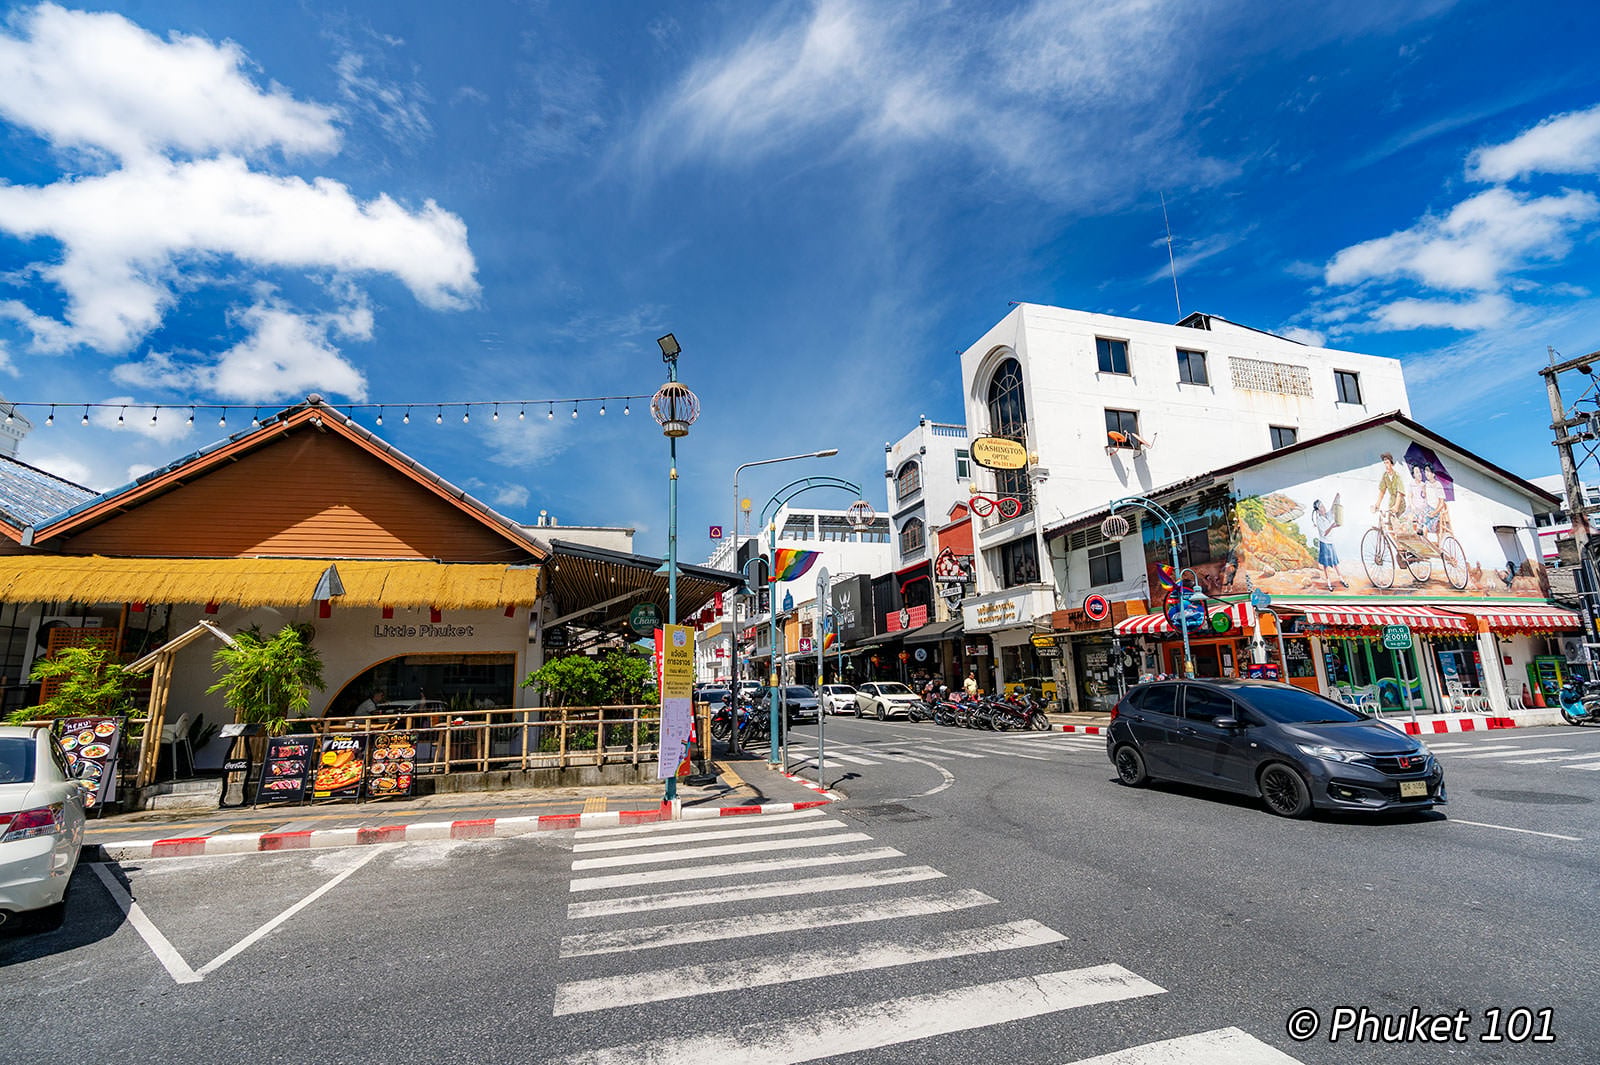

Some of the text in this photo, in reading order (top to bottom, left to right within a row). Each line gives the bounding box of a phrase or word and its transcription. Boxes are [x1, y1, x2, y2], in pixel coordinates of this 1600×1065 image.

[977, 444, 1024, 455] WASHINGTON
[633, 616, 660, 626] Chang
[374, 623, 474, 638] Little Phuket
[331, 740, 360, 750] PIZZA
